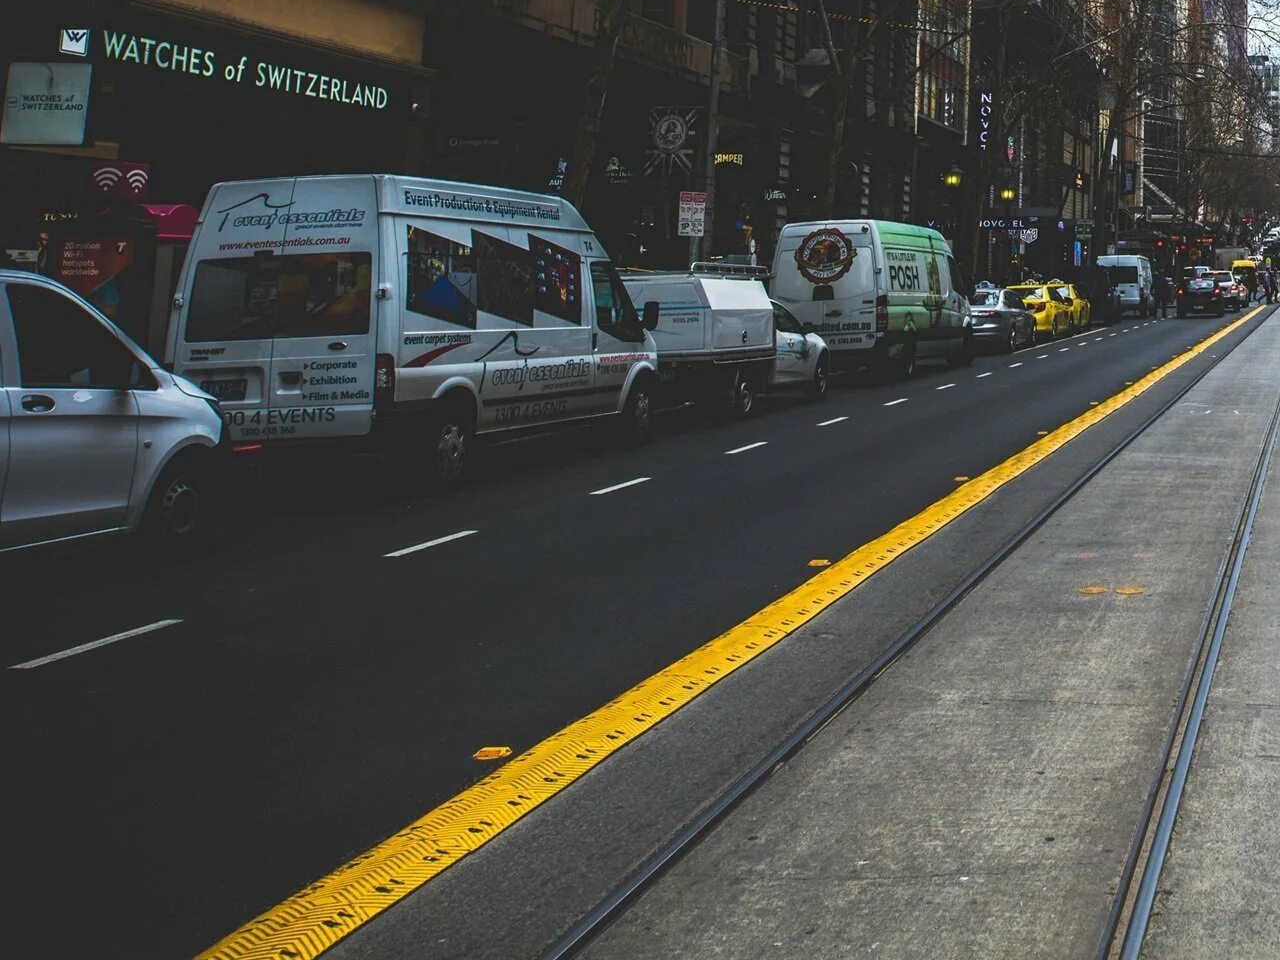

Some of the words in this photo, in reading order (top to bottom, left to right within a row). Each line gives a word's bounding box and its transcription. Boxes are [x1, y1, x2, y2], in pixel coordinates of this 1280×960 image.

[103, 29, 215, 78] WATCHES
[224, 55, 248, 83] of
[255, 62, 389, 110] SWITZERLAND
[22, 93, 63, 103] WATCHES
[65, 94, 75, 103] of
[21, 102, 84, 112] SWITZERLAND
[404, 190, 433, 206] Event
[434, 193, 485, 213] Production
[485, 200, 494, 213] &
[494, 200, 537, 219] Equipment
[537, 206, 560, 221] Rental
[233, 209, 278, 230] event
[278, 208, 366, 226] essentials
[219, 236, 352, 252] www.eventessentials.com.au
[584, 241, 593, 252] T4
[888, 265, 921, 290] POSH
[404, 335, 424, 345] event
[425, 334, 447, 346] carpet
[447, 333, 472, 345] systems
[310, 360, 357, 372] Corporate
[309, 376, 357, 386] Exhibition
[492, 359, 529, 390] event
[529, 358, 591, 383] essentials
[309, 393, 330, 401] Film
[330, 392, 339, 400] &
[340, 391, 370, 400] Media
[250, 411, 262, 425] 4
[268, 408, 336, 425] EVENTS
